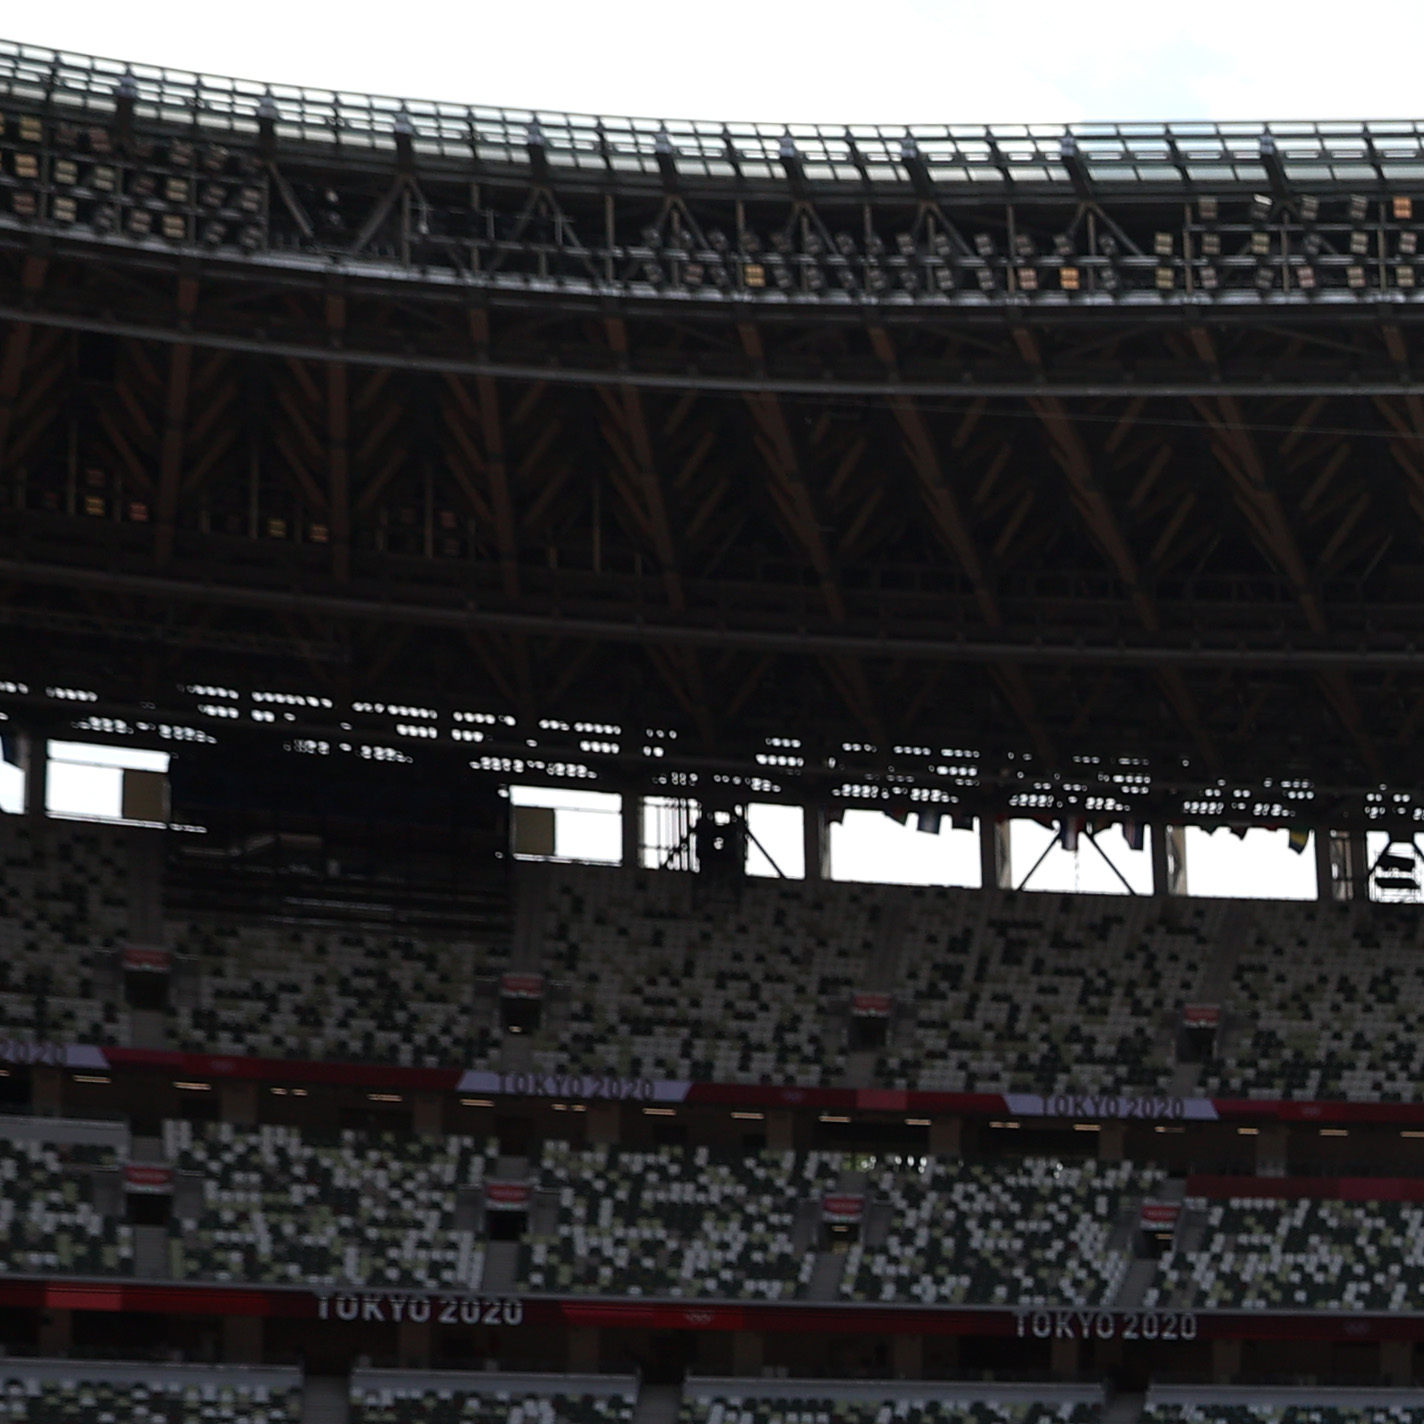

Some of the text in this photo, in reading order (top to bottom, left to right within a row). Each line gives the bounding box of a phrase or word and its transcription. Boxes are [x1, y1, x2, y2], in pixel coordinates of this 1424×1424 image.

[496, 1071, 655, 1103] TOKYO 2020
[1038, 1094, 1184, 1120] TOKYO 2020
[314, 1293, 524, 1326] TOKYO 2020
[1012, 1310, 1198, 1341] TOKYO 2020
